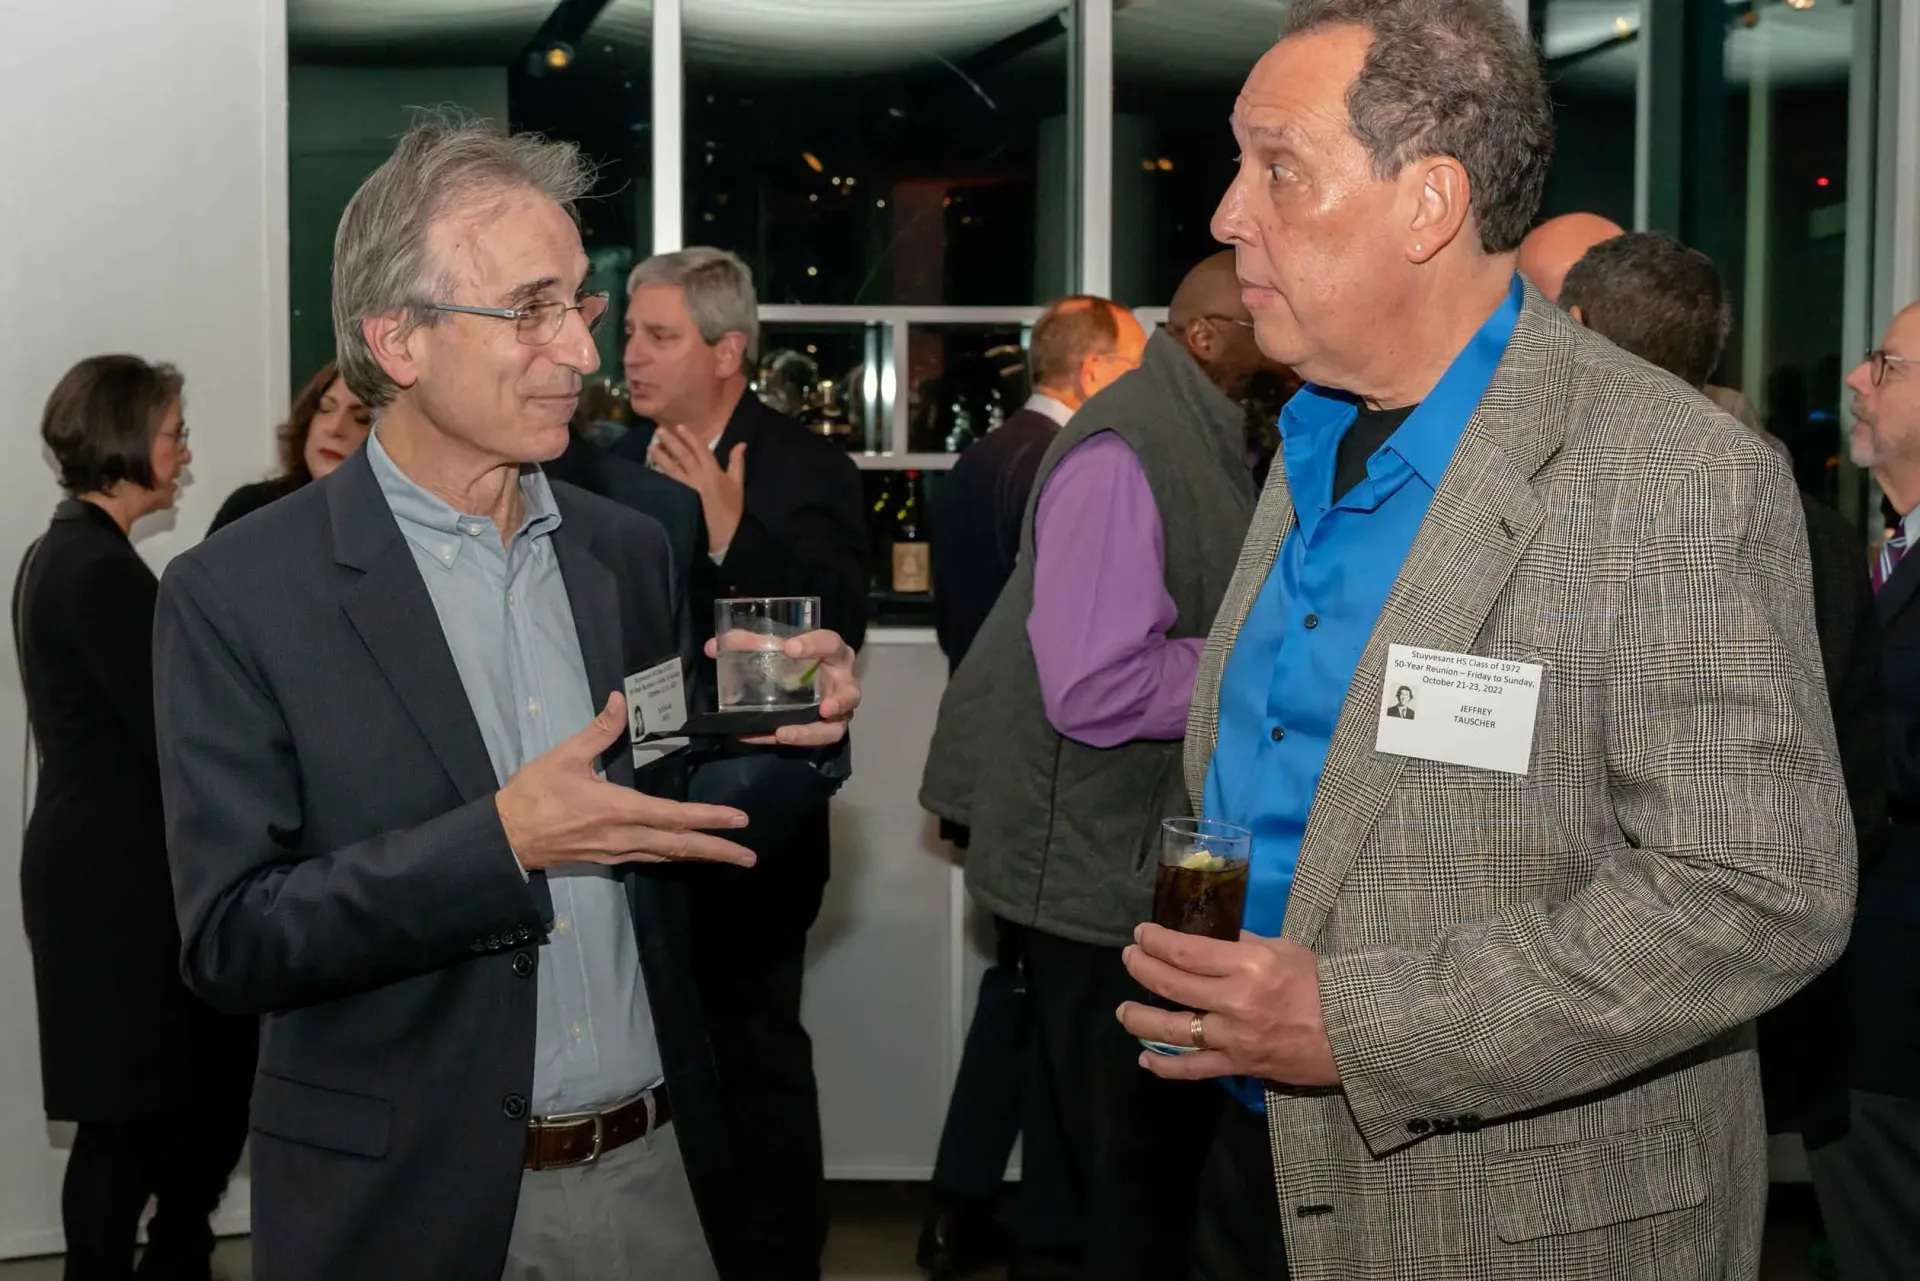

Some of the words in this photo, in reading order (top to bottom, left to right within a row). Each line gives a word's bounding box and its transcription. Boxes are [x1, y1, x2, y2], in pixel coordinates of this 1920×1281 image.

[1412, 651, 1454, 664] Stuyvesant
[1456, 657, 1467, 665] HS
[1468, 659, 1488, 668] Class
[1501, 663, 1521, 673] 1972
[1394, 660, 1425, 671] 50-Year
[1426, 665, 1458, 676] Reunion
[1467, 671, 1492, 682] Friday
[1503, 676, 1535, 688] Sunday,
[1422, 676, 1454, 687] October
[1456, 681, 1481, 692] 21-23,
[1483, 684, 1503, 694] 2022
[1460, 705, 1492, 716] JEFFREY
[1454, 716, 1496, 729] TAUSCHER
